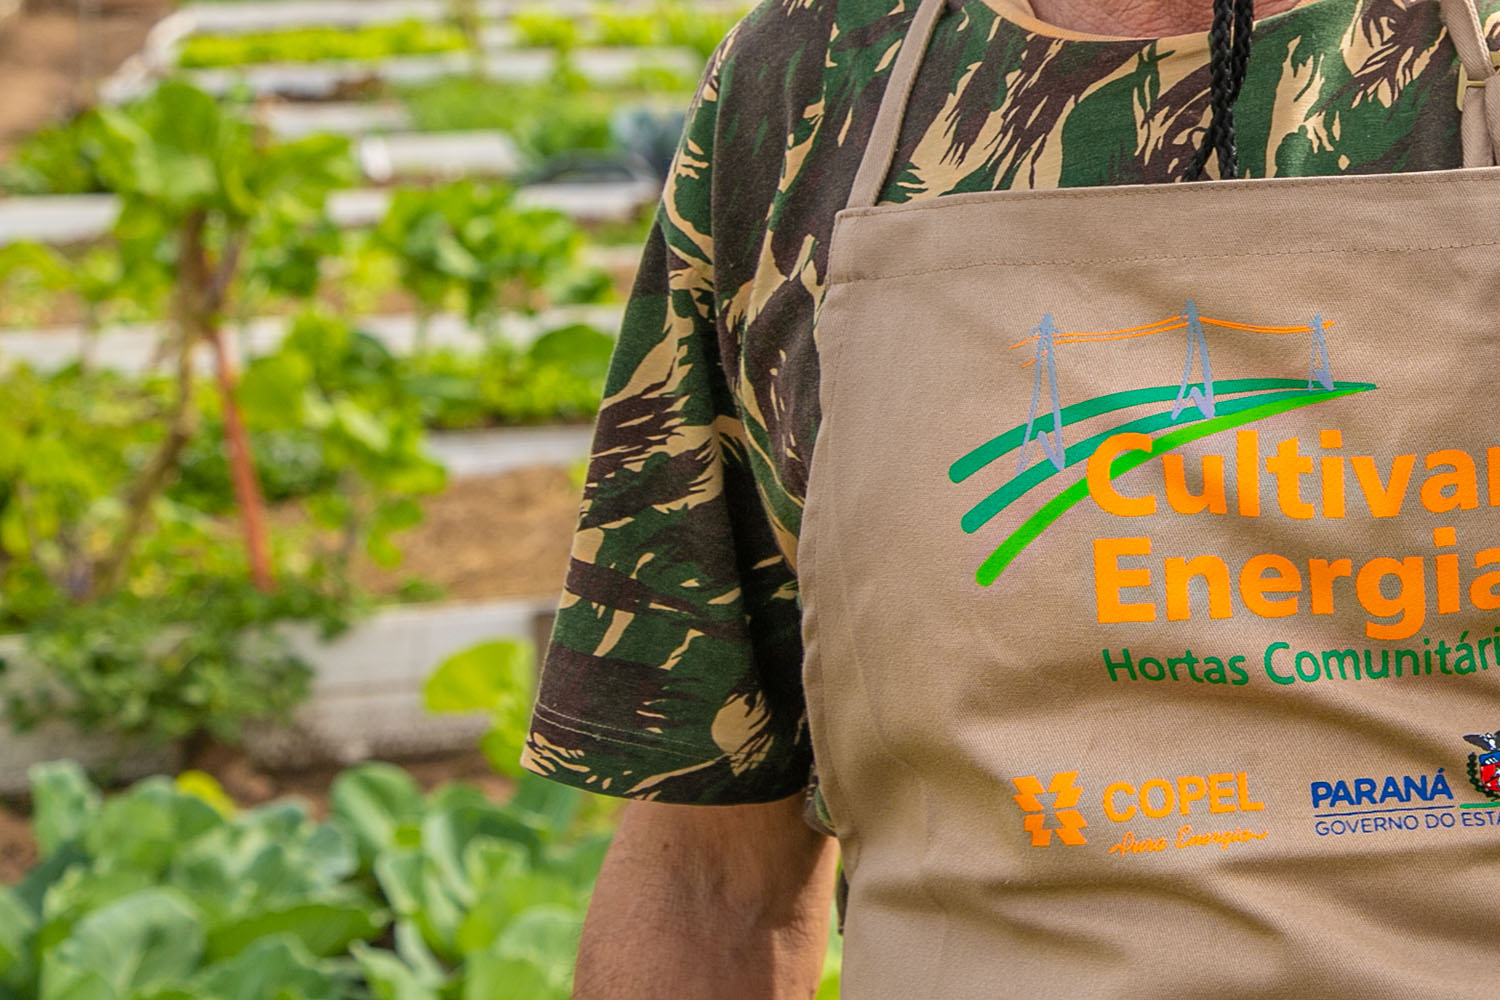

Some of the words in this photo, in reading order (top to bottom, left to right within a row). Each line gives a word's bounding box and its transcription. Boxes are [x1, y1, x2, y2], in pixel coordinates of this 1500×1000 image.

[1103, 648, 1249, 686] Hortas
[1102, 771, 1265, 822] COPEL
[1311, 768, 1454, 808] PARANÁ
[1315, 814, 1419, 836] GOVERNO
[1425, 812, 1455, 829] DO
